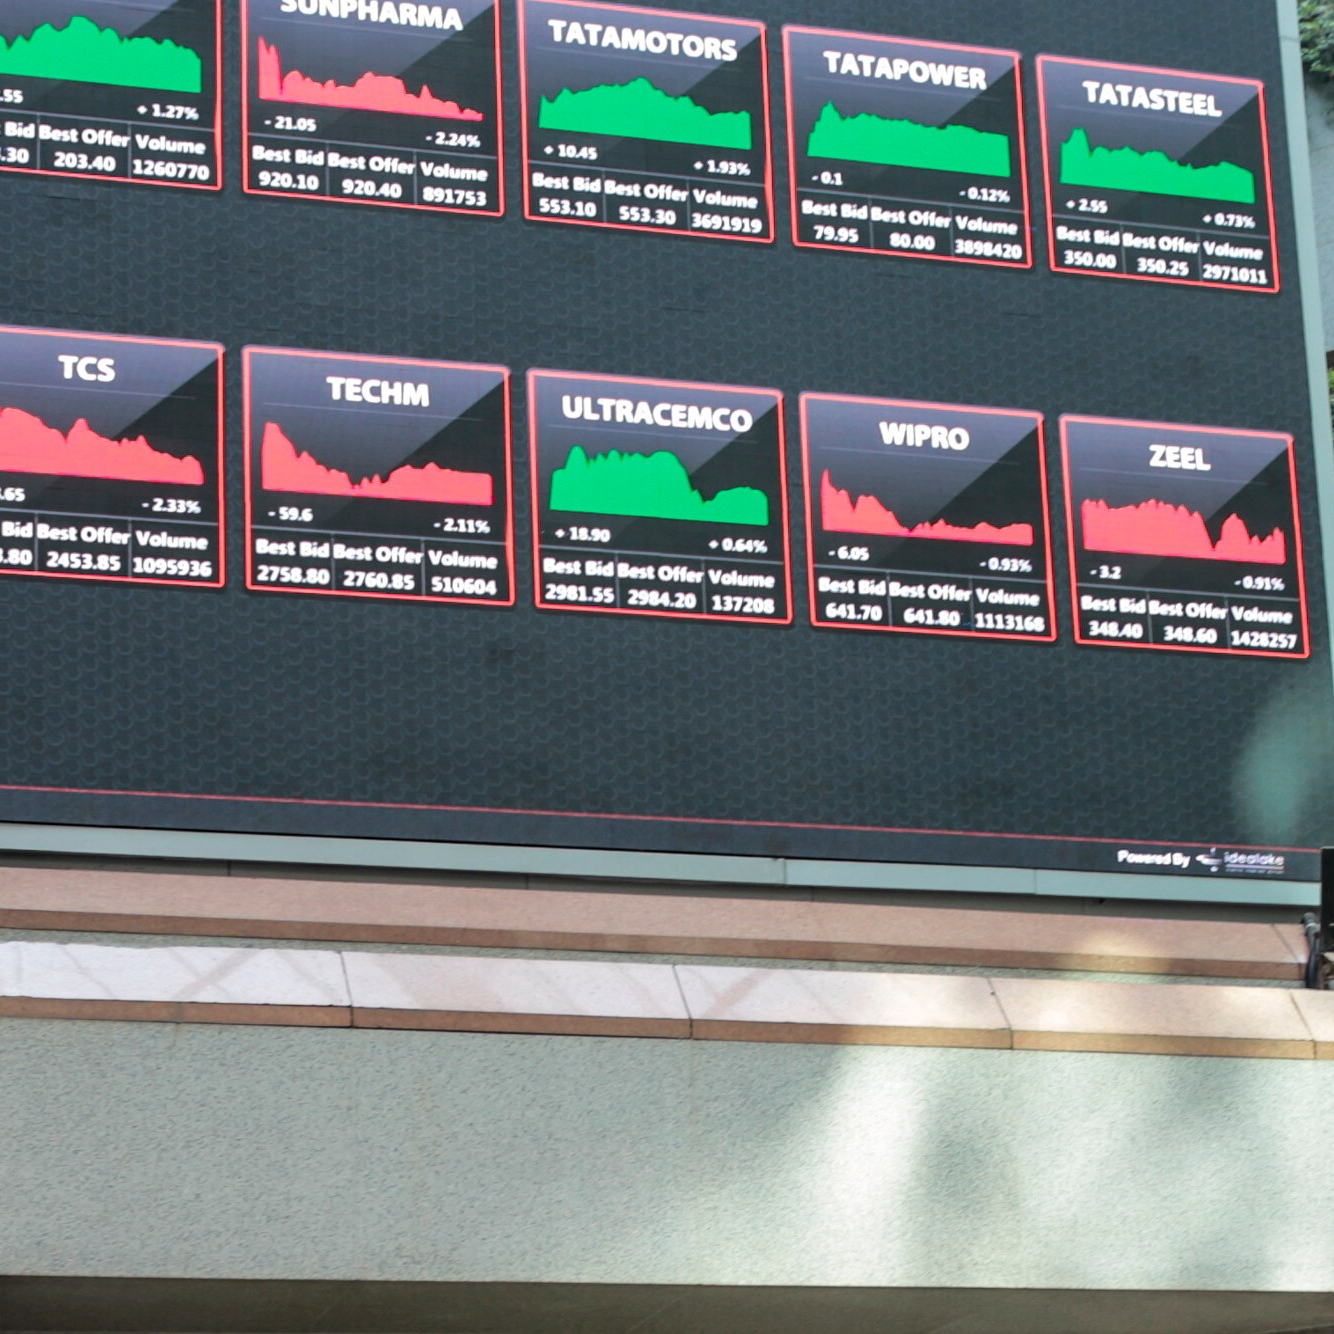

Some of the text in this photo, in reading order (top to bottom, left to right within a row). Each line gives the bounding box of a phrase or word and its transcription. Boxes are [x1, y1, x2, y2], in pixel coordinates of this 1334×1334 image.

[280, 0, 464, 31] SUNPHARMA
[548, 19, 738, 61] TATAMOTORS
[823, 50, 987, 90] TATAPOWER
[1082, 80, 1222, 117] TATASTEEL
[152, 104, 199, 120] 1.27%
[4, 120, 35, 138] Bid
[274, 115, 317, 132] 21.05
[38, 125, 130, 148] Best Offer
[135, 134, 206, 156] Volume
[435, 132, 481, 148] 2.24%
[54, 152, 116, 172] 203.40
[252, 145, 324, 166] Best Bid
[557, 144, 598, 161] 10.45
[132, 159, 210, 180] 1260770
[328, 152, 416, 175] Best Offer
[420, 162, 489, 182] Volume
[707, 159, 751, 176] 1.93%
[258, 171, 319, 190] 920.10
[532, 172, 602, 194] Best Bid
[821, 171, 843, 186] 0.1
[342, 179, 402, 199] 920.40
[422, 187, 487, 207] 891753
[604, 180, 689, 202] Best Offer
[692, 188, 759, 209] Volume
[968, 187, 1011, 203] 0.12%
[539, 197, 597, 217] 553.10
[619, 205, 677, 226] 553.30
[801, 200, 868, 220] Best Bid
[1078, 199, 1108, 214] 2.55
[691, 212, 762, 234] 3691919
[870, 206, 952, 229] Best Offer
[955, 215, 1018, 236] Volume
[1214, 213, 1256, 229] 0.73%
[813, 225, 859, 243] 79.95
[890, 232, 935, 251] 80.00
[1056, 225, 1120, 247] Best Bid
[1123, 232, 1200, 254] Best Offer
[955, 239, 1023, 260] 3898420
[1064, 250, 1117, 269] 350.00
[1203, 240, 1263, 260] Volume
[1137, 258, 1189, 277] 350.25
[1202, 264, 1267, 285] 2971011
[57, 354, 117, 382] TCS
[326, 376, 430, 407] TECHM
[562, 395, 754, 432] ULTRACEMCO
[879, 421, 970, 451] WIPRO
[1149, 444, 1212, 471] ZEEL
[152, 497, 201, 514] 2.33%
[279, 506, 314, 523] 59.6
[2, 521, 34, 538] Bid
[36, 523, 131, 545] Best Offer
[443, 518, 490, 534] 2.11%
[569, 526, 611, 543] 18.90
[135, 530, 209, 551] Volume
[255, 538, 330, 559] Best Bid
[722, 537, 768, 553] 0.64%
[46, 551, 121, 572] 2453.85
[333, 543, 423, 565] Best Offer
[428, 549, 498, 570] Volume
[837, 546, 870, 561] 6.05
[132, 557, 212, 578] 1095936
[257, 565, 331, 585] 2758.80
[543, 557, 614, 578] Best Bid
[617, 562, 704, 584] Best Offer
[988, 557, 1032, 573] 0.93%
[1099, 565, 1122, 580] 3.2
[343, 570, 415, 591] 2760.85
[431, 576, 497, 596] 510604
[708, 568, 776, 589] Volume
[818, 576, 887, 597] Best Bid
[1242, 576, 1285, 591] 0.91%
[545, 583, 615, 604] 2981.55
[627, 589, 697, 609] 2984.20
[889, 581, 972, 602] Best Offer
[976, 588, 1041, 607] Volume
[711, 594, 776, 614] 137208
[826, 602, 883, 621] 641.70
[1080, 596, 1147, 615] Best Bid
[1149, 600, 1228, 620] Best Offer
[903, 607, 960, 626] 641.80
[975, 612, 1046, 632] 1113168
[1231, 606, 1293, 625] Volume
[1089, 621, 1144, 639] 348.40
[1163, 626, 1218, 644] 348.60
[1231, 630, 1297, 650] 1428257
[1117, 850, 1172, 866] Powered
[1173, 853, 1191, 868] By
